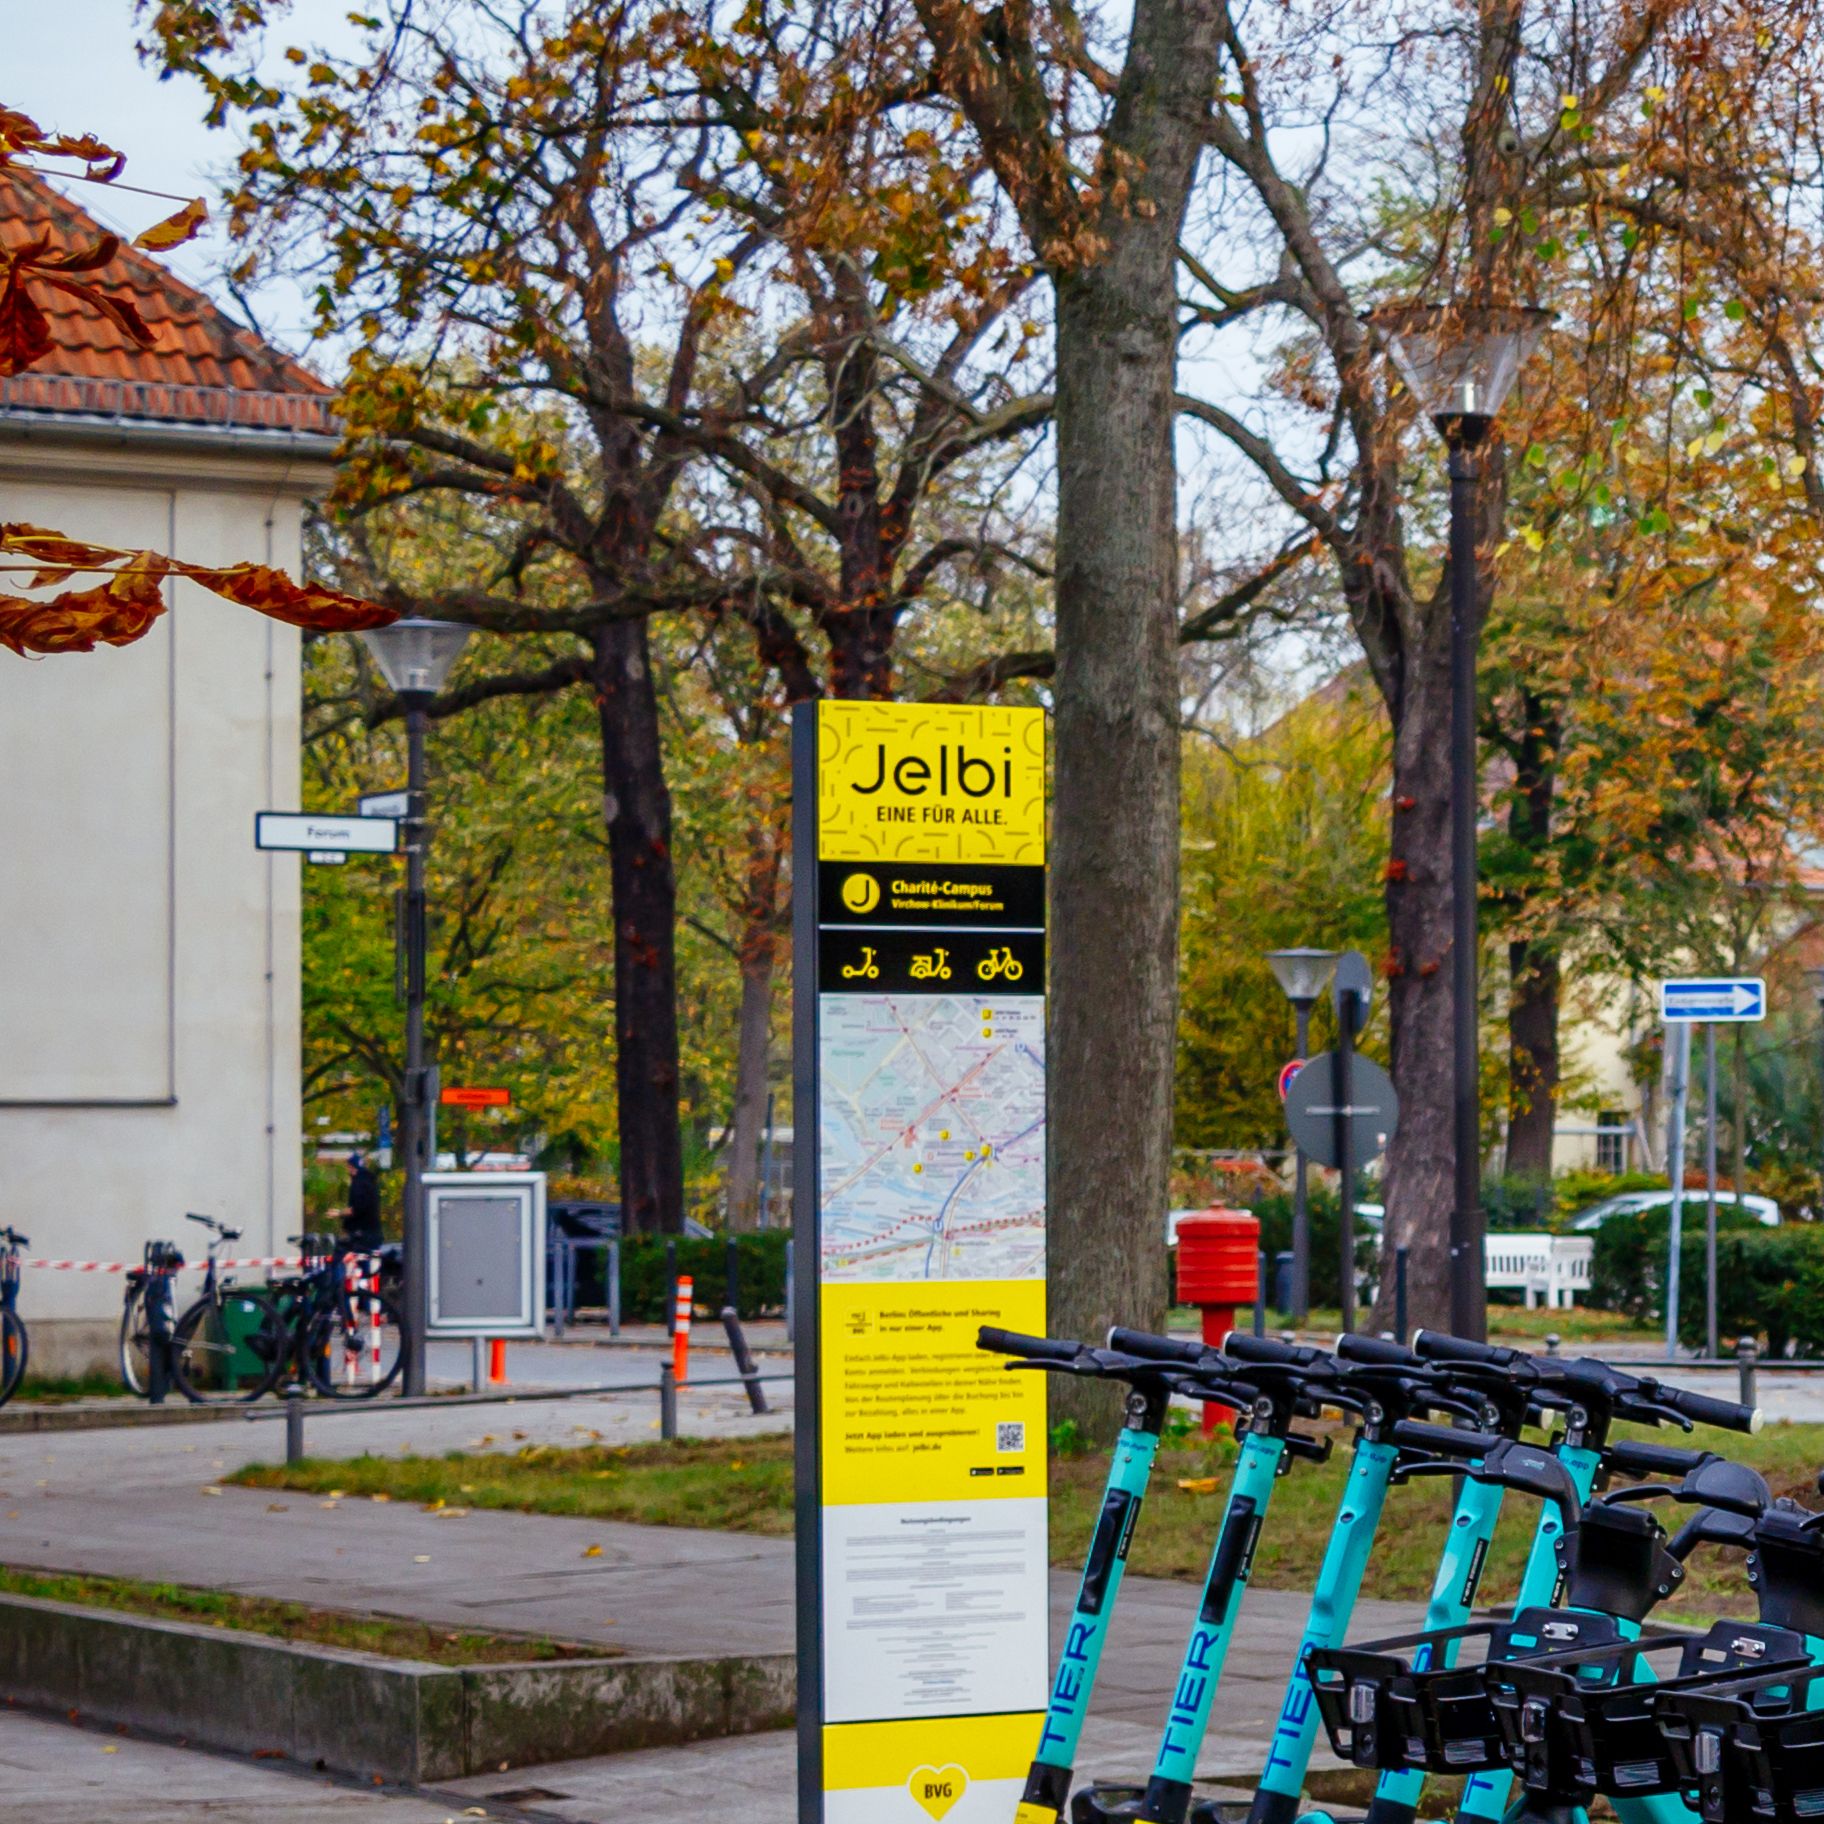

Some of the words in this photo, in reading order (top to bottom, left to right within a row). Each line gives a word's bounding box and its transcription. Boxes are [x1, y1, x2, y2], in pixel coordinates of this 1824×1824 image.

[851, 744, 1011, 797] Jelbi
[877, 806, 915, 823] EINE
[922, 804, 955, 824] FÜR
[962, 808, 1008, 825] ALLE.
[892, 880, 993, 897] Charité-Campus
[1038, 1622, 1098, 1755] TIER
[1158, 1630, 1220, 1767] TIER
[925, 1782, 953, 1799] BVG
